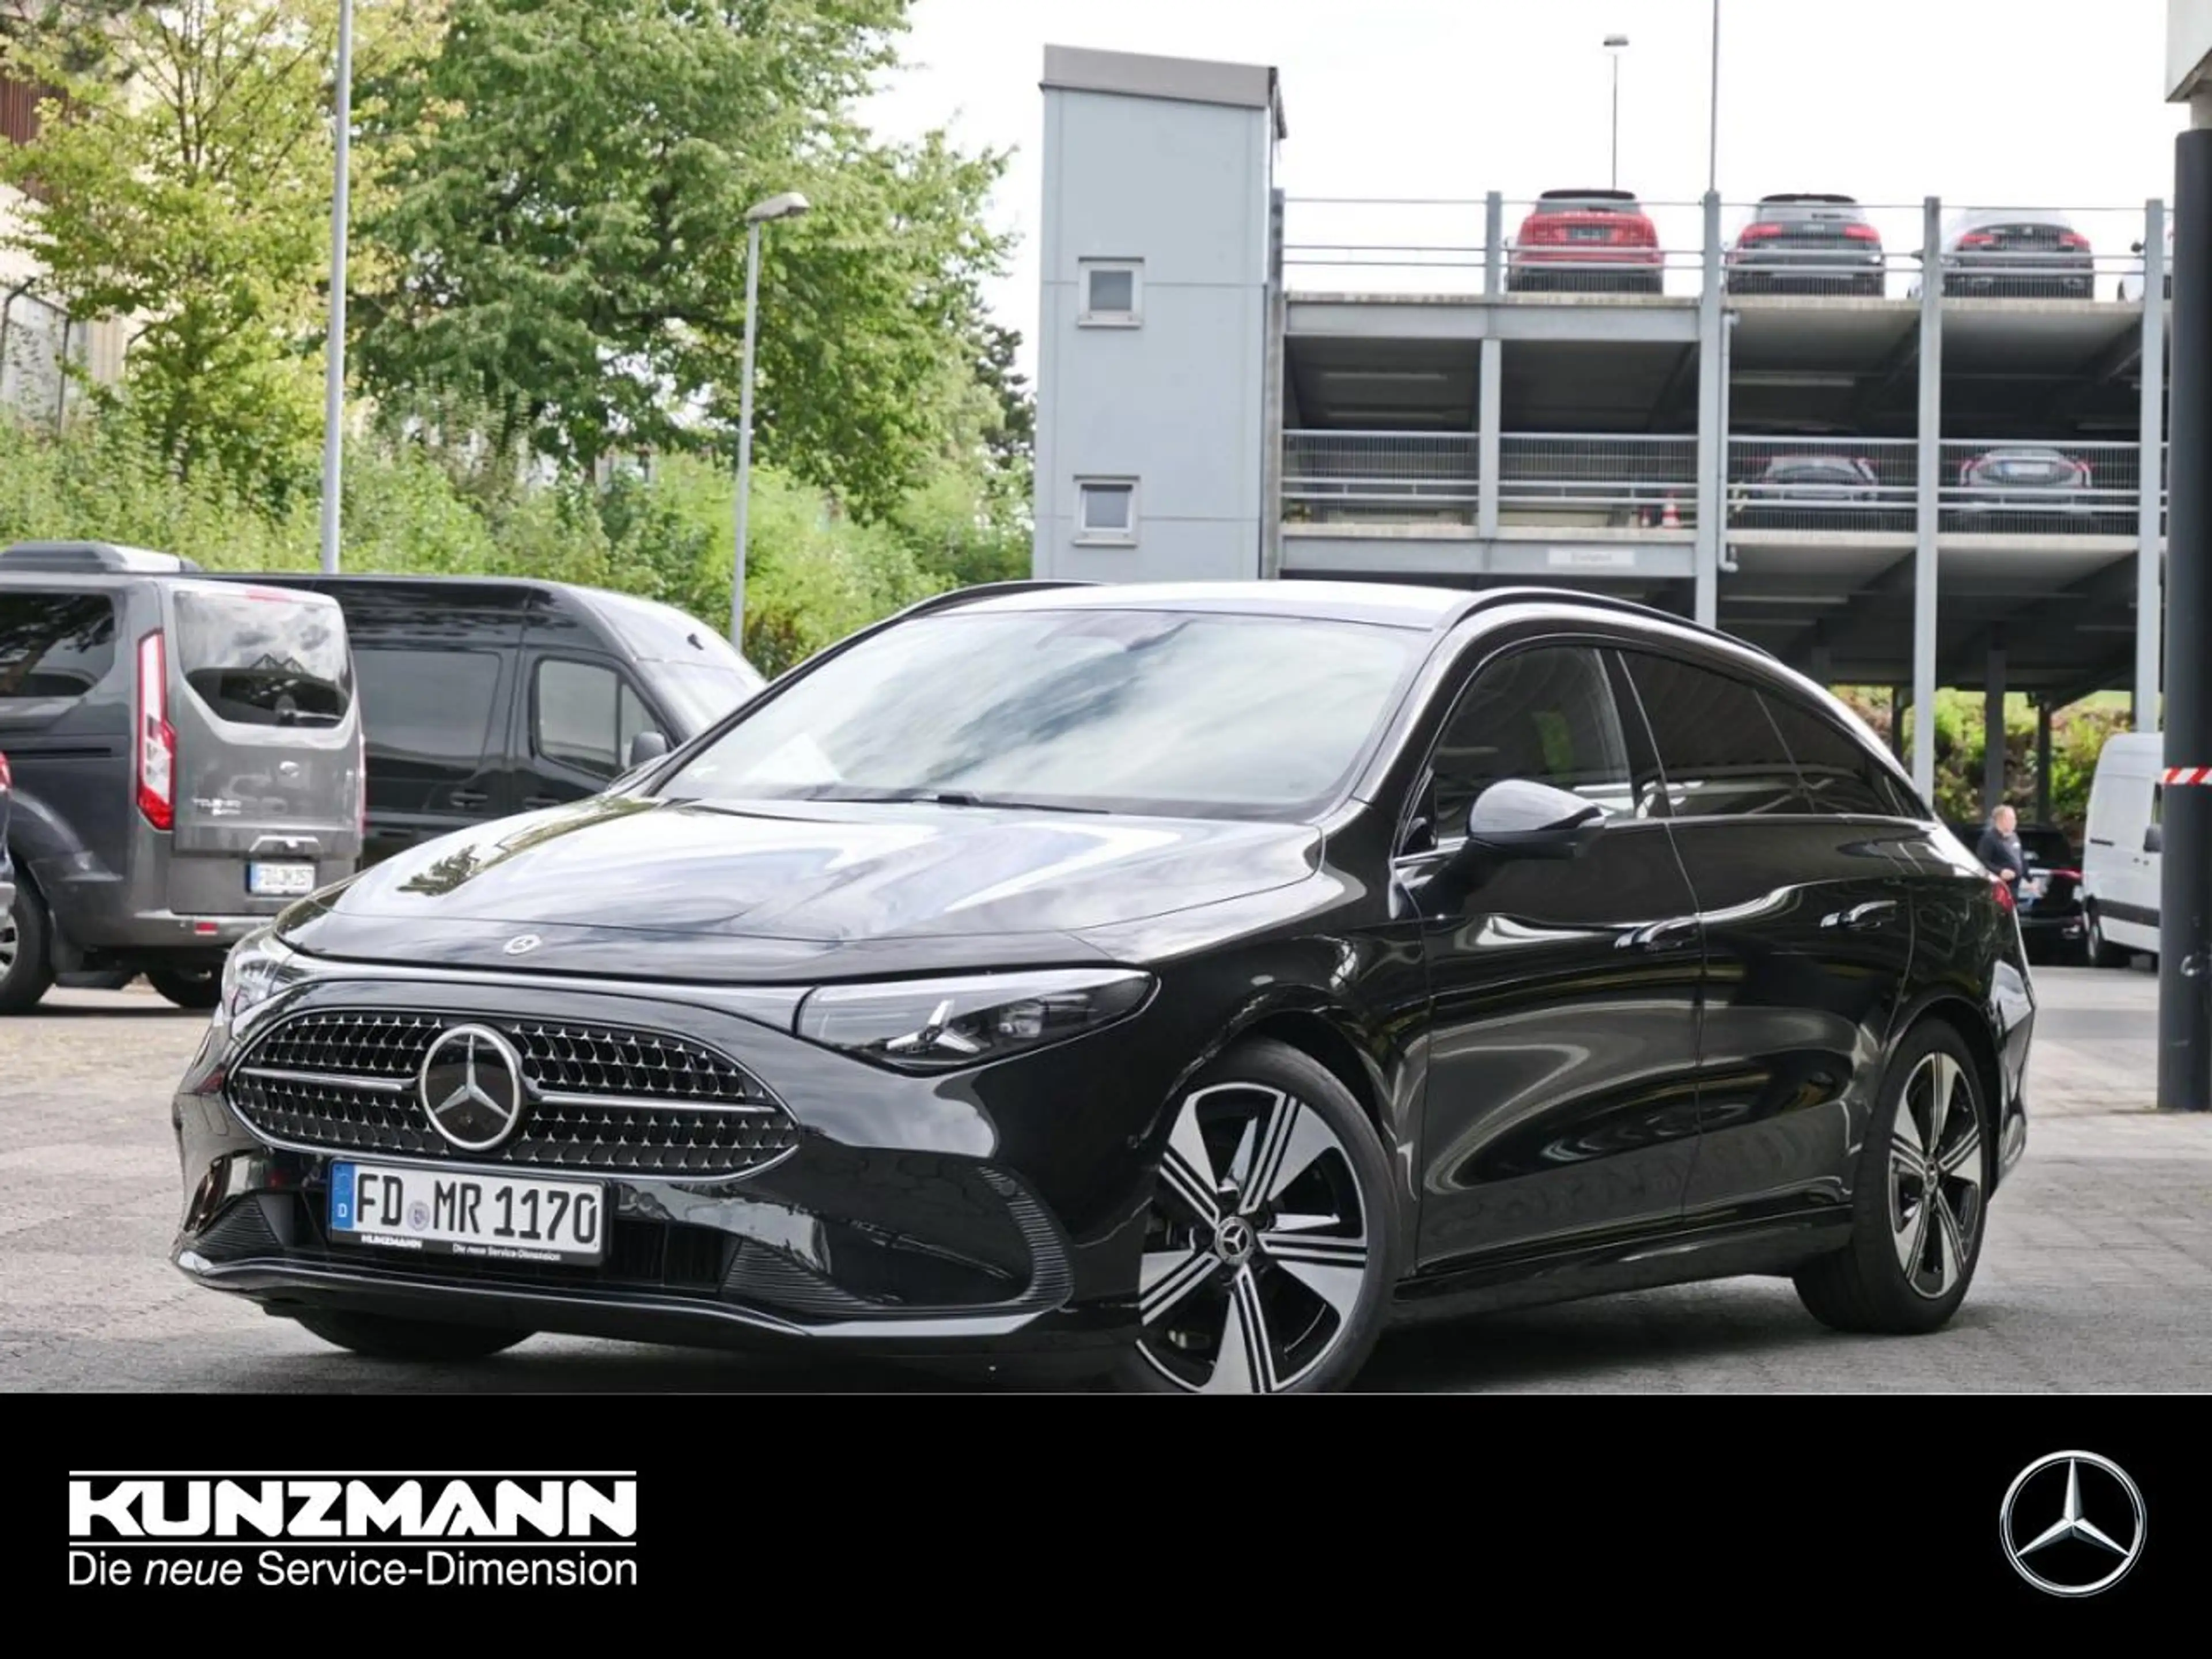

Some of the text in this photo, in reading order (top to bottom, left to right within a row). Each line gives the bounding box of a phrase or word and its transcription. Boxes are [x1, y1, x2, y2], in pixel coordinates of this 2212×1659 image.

[338, 1202, 347, 1218] D
[357, 1173, 597, 1244] FD MR 1170
